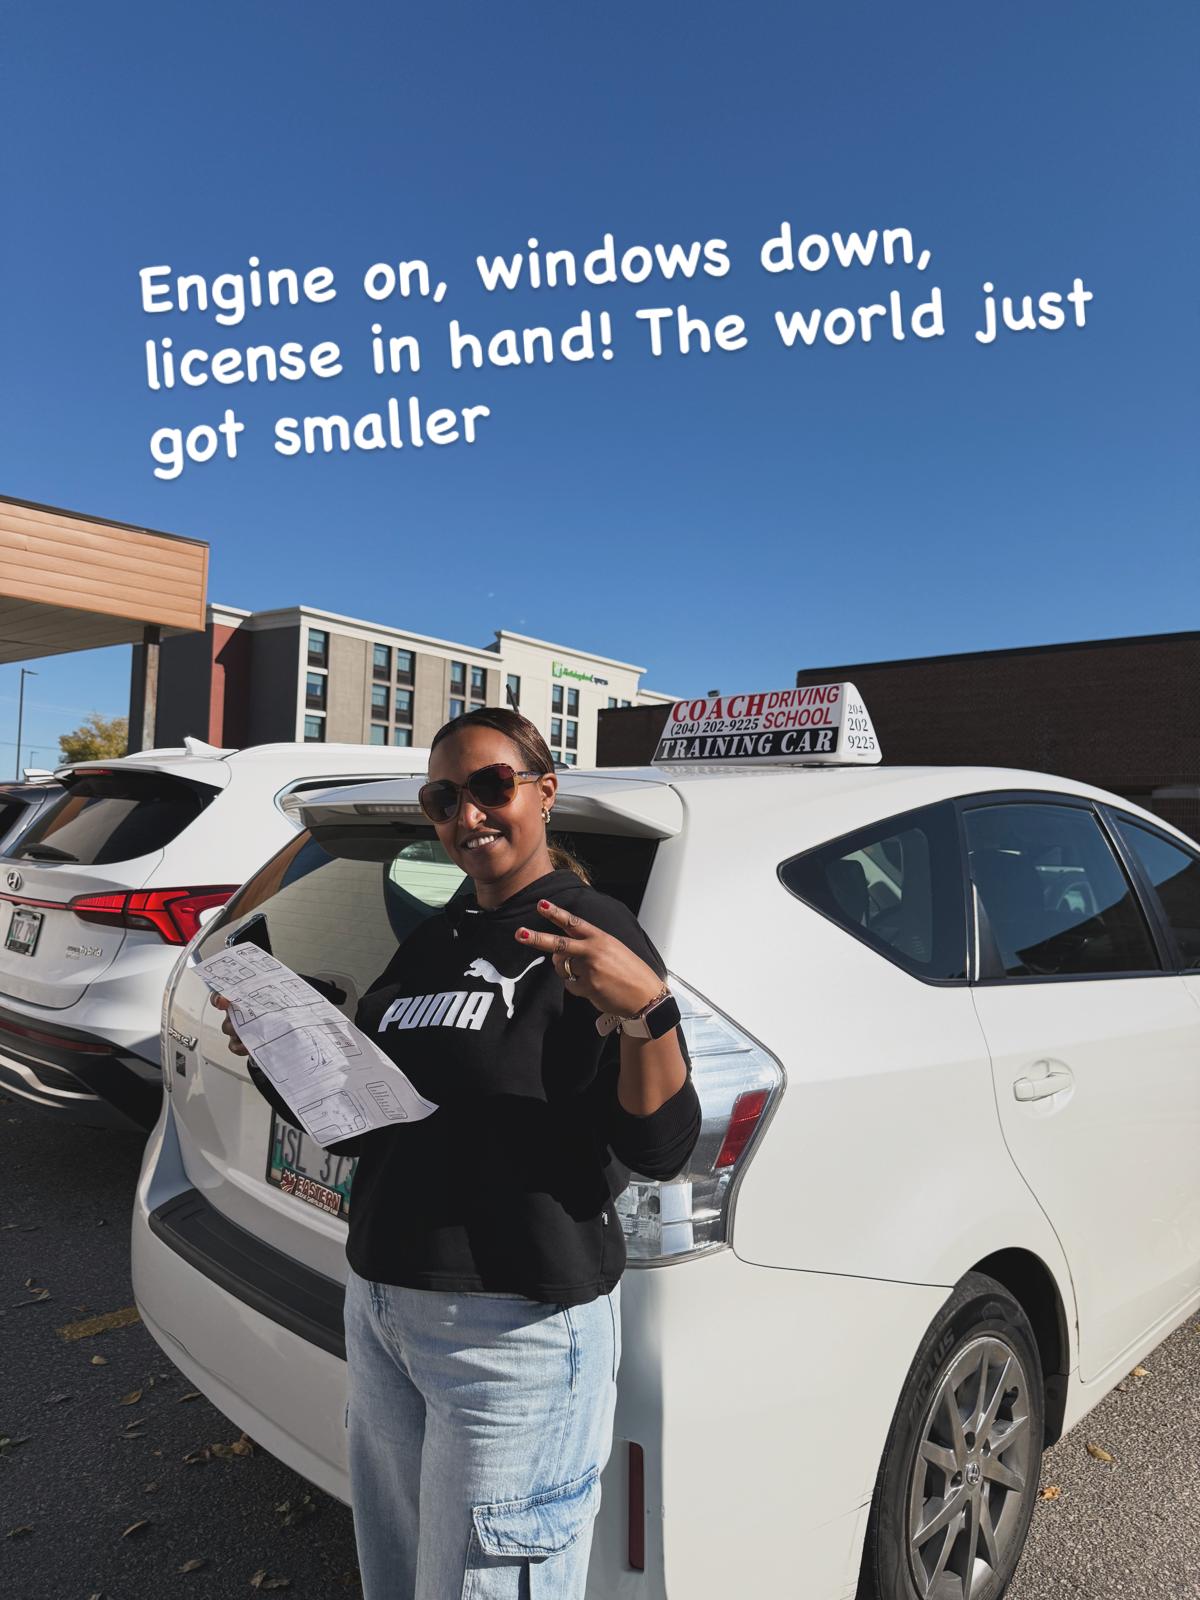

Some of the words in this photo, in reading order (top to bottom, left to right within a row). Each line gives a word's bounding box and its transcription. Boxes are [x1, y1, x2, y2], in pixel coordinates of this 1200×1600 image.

[672, 694, 768, 722] COACH
[767, 686, 840, 709] DRIVING
[848, 704, 863, 714] 204
[671, 721, 700, 737] (204)
[702, 718, 759, 733] 202-9225
[763, 707, 832, 729] SCHOOL
[848, 717, 868, 732] 202
[661, 733, 773, 759] TRAINING
[780, 730, 833, 753] CAR
[848, 735, 875, 750] 9225
[378, 991, 495, 1032] PUMA
[296, 1176, 342, 1211] EASTERN
